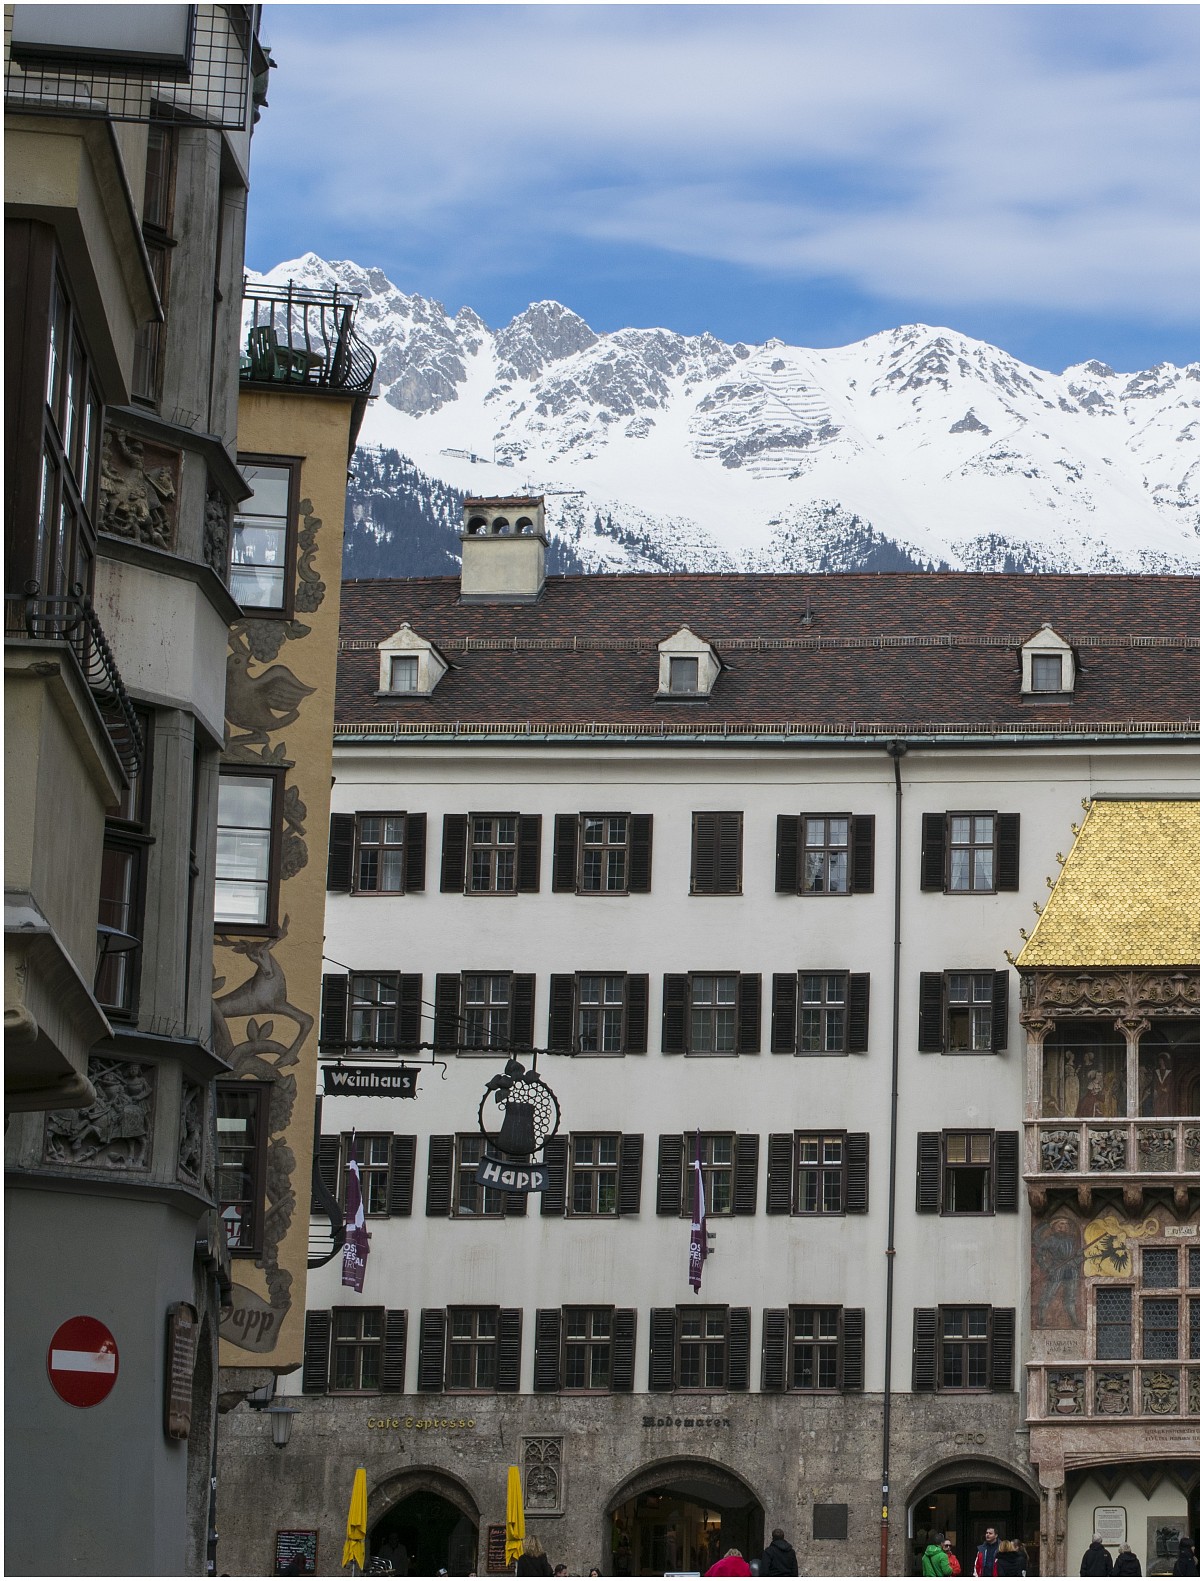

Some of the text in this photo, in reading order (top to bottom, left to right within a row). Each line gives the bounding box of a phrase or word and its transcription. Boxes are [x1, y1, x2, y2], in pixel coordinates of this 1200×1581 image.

[331, 1069, 411, 1088] Weinhaus
[482, 1162, 543, 1189] Happ
[367, 1416, 476, 1430] Cafe Espresso
